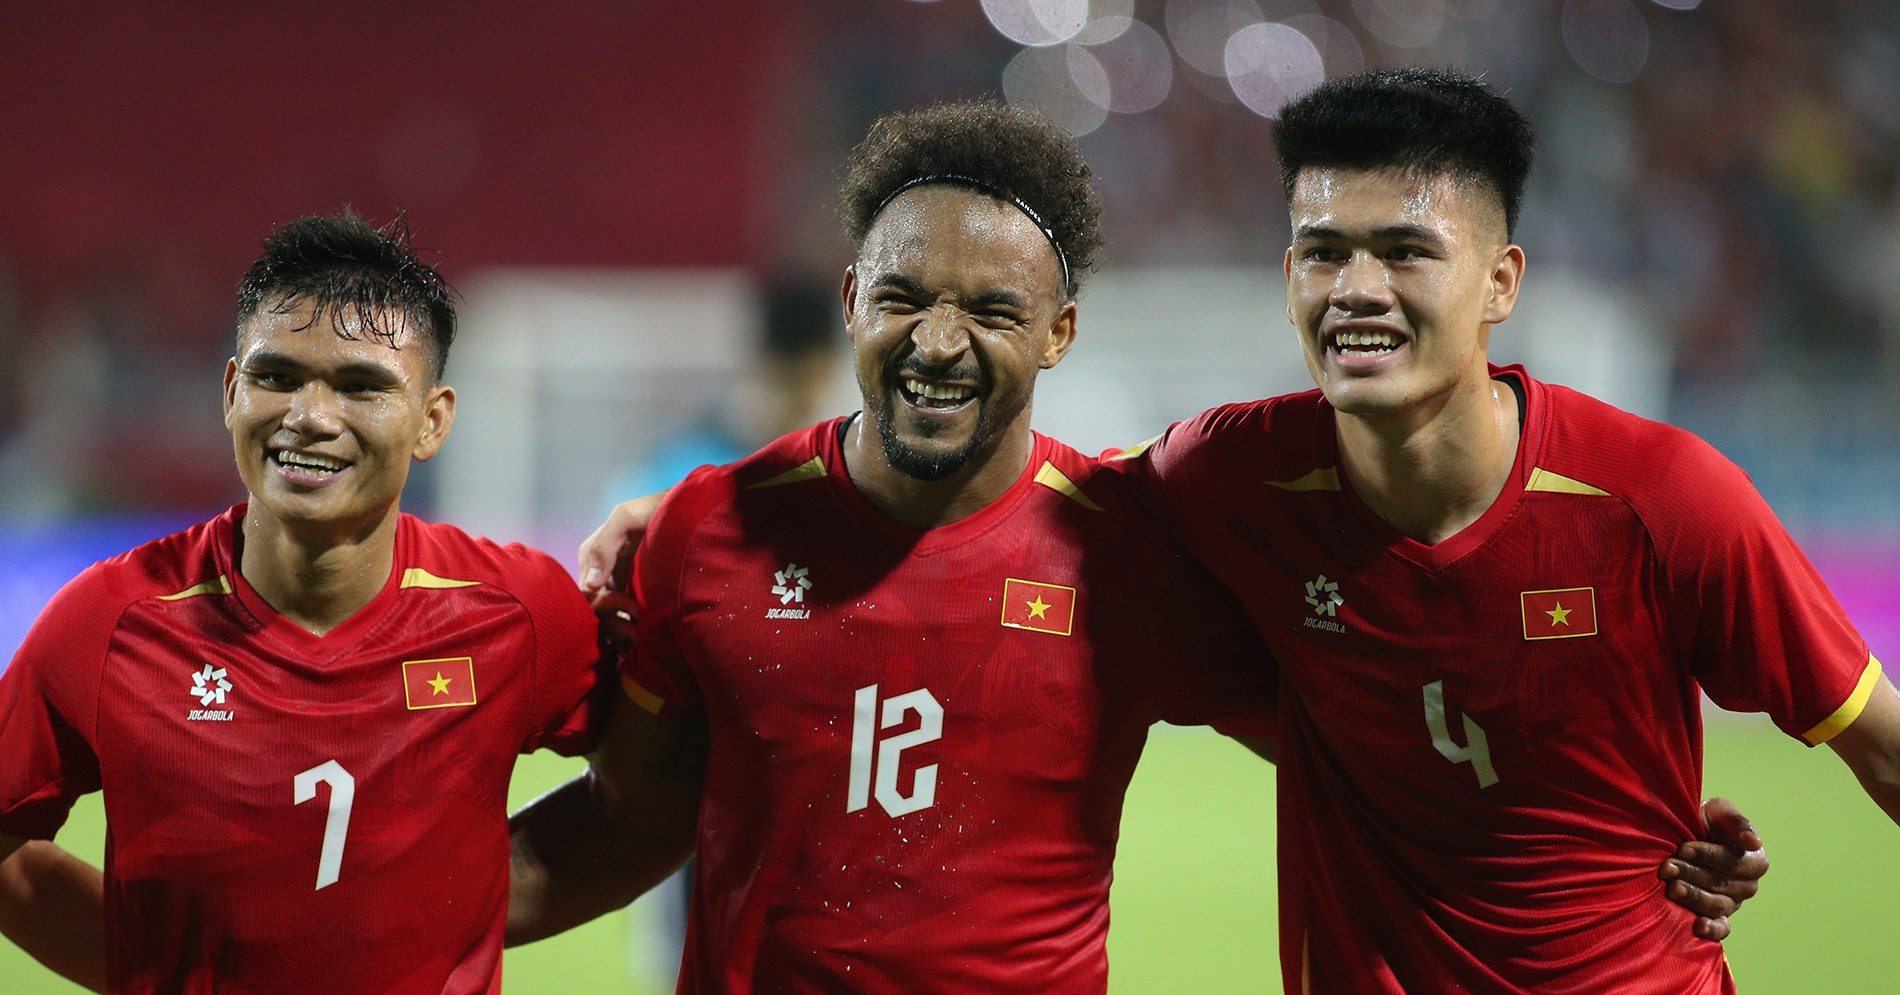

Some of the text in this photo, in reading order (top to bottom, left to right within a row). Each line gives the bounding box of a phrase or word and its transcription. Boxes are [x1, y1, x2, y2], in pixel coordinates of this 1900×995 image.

[764, 608, 811, 620] JOGARBOLA
[1303, 616, 1346, 634] JOGARBOLA
[186, 709, 234, 721] JOGARBOLA
[1422, 679, 1500, 790] 4
[846, 683, 945, 819] 12
[293, 758, 356, 891] 7
